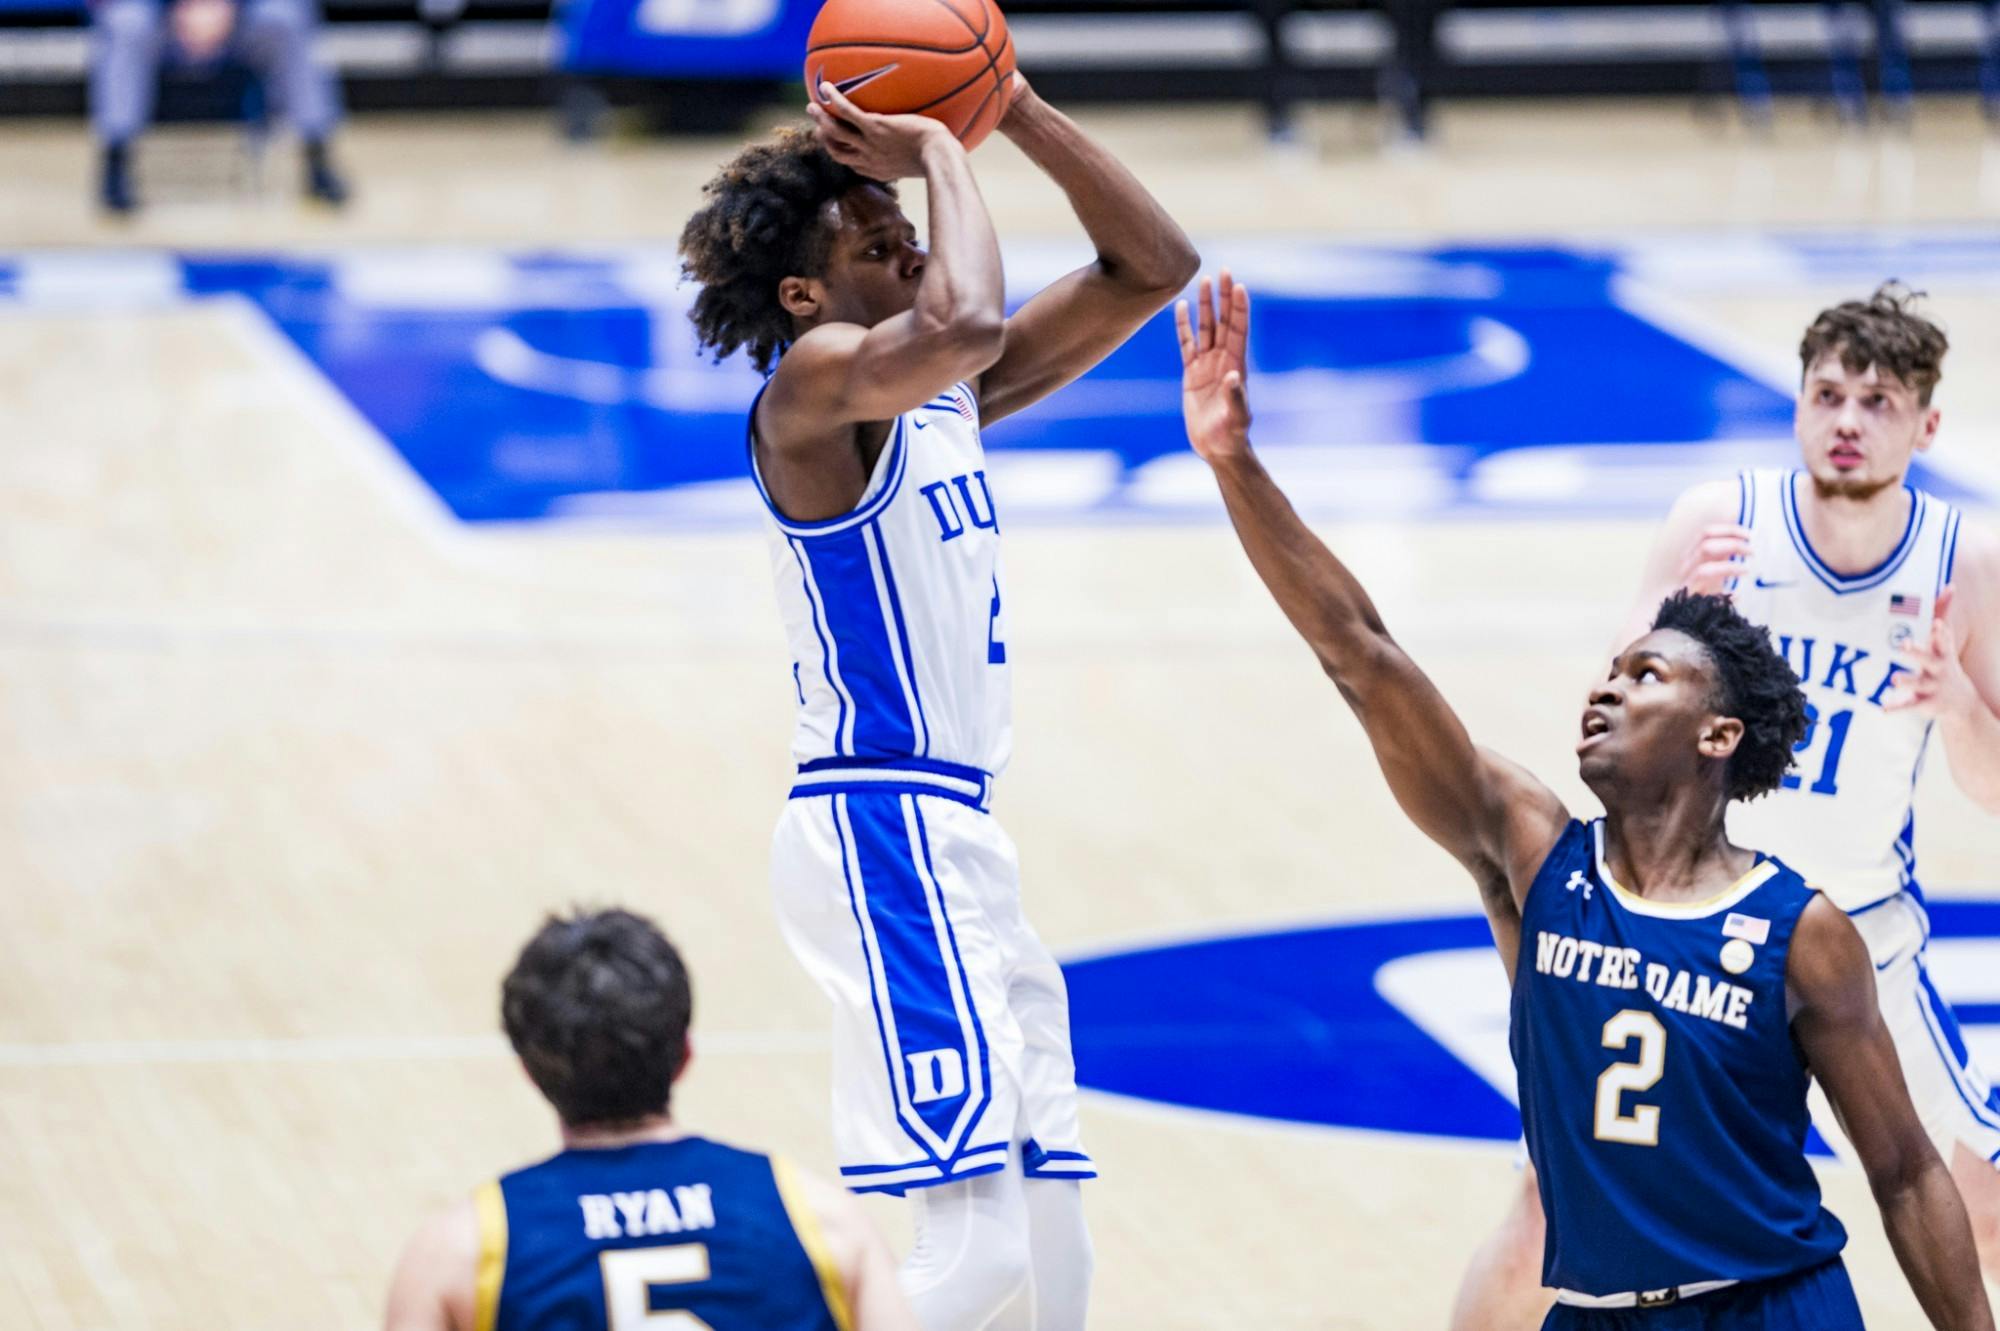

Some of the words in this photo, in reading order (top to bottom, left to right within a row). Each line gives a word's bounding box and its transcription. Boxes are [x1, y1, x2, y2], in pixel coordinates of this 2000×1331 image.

[919, 470, 1000, 542] DU
[1536, 931, 1642, 989] NOTRE
[1645, 962, 1754, 1031] DAME
[905, 1047, 965, 1105] D
[1594, 1009, 1667, 1147] 2
[577, 1182, 716, 1240] RYAN
